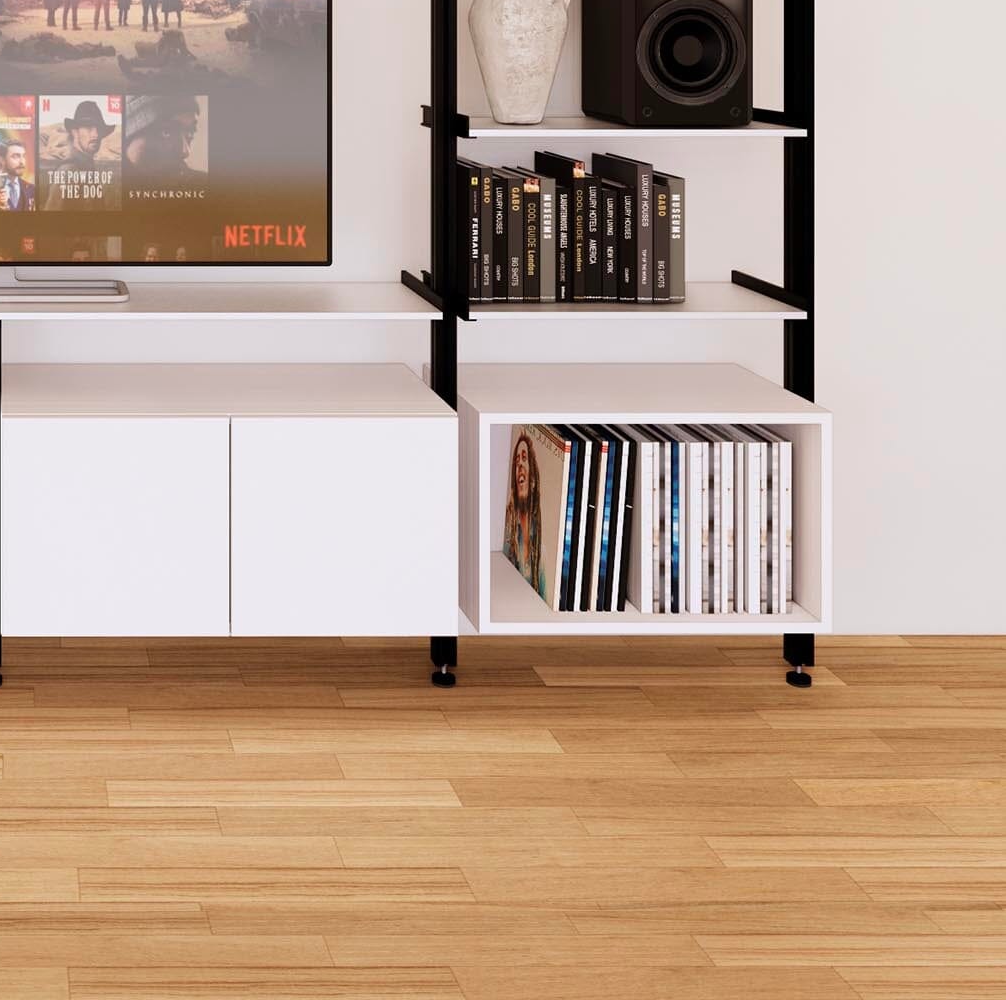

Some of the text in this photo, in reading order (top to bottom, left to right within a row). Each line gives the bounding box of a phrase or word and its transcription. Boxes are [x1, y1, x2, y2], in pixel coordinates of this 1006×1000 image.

[48, 171, 113, 184] THE POWER OF
[60, 185, 103, 198] THE DOG
[129, 190, 205, 199] SYNCHRONIC
[512, 187, 520, 211] GABO
[641, 174, 649, 227] LUXURY HOUSES
[543, 194, 552, 239] MUSEUMS
[658, 194, 666, 217] GABO
[672, 194, 681, 239] MUSEUMS
[224, 225, 307, 248] NETFLIX
[588, 186, 597, 264] LUXURY HOTELS AMERICA
[527, 203, 536, 275] COOL GUIDE London
[657, 260, 665, 288] BIG SHOTS
